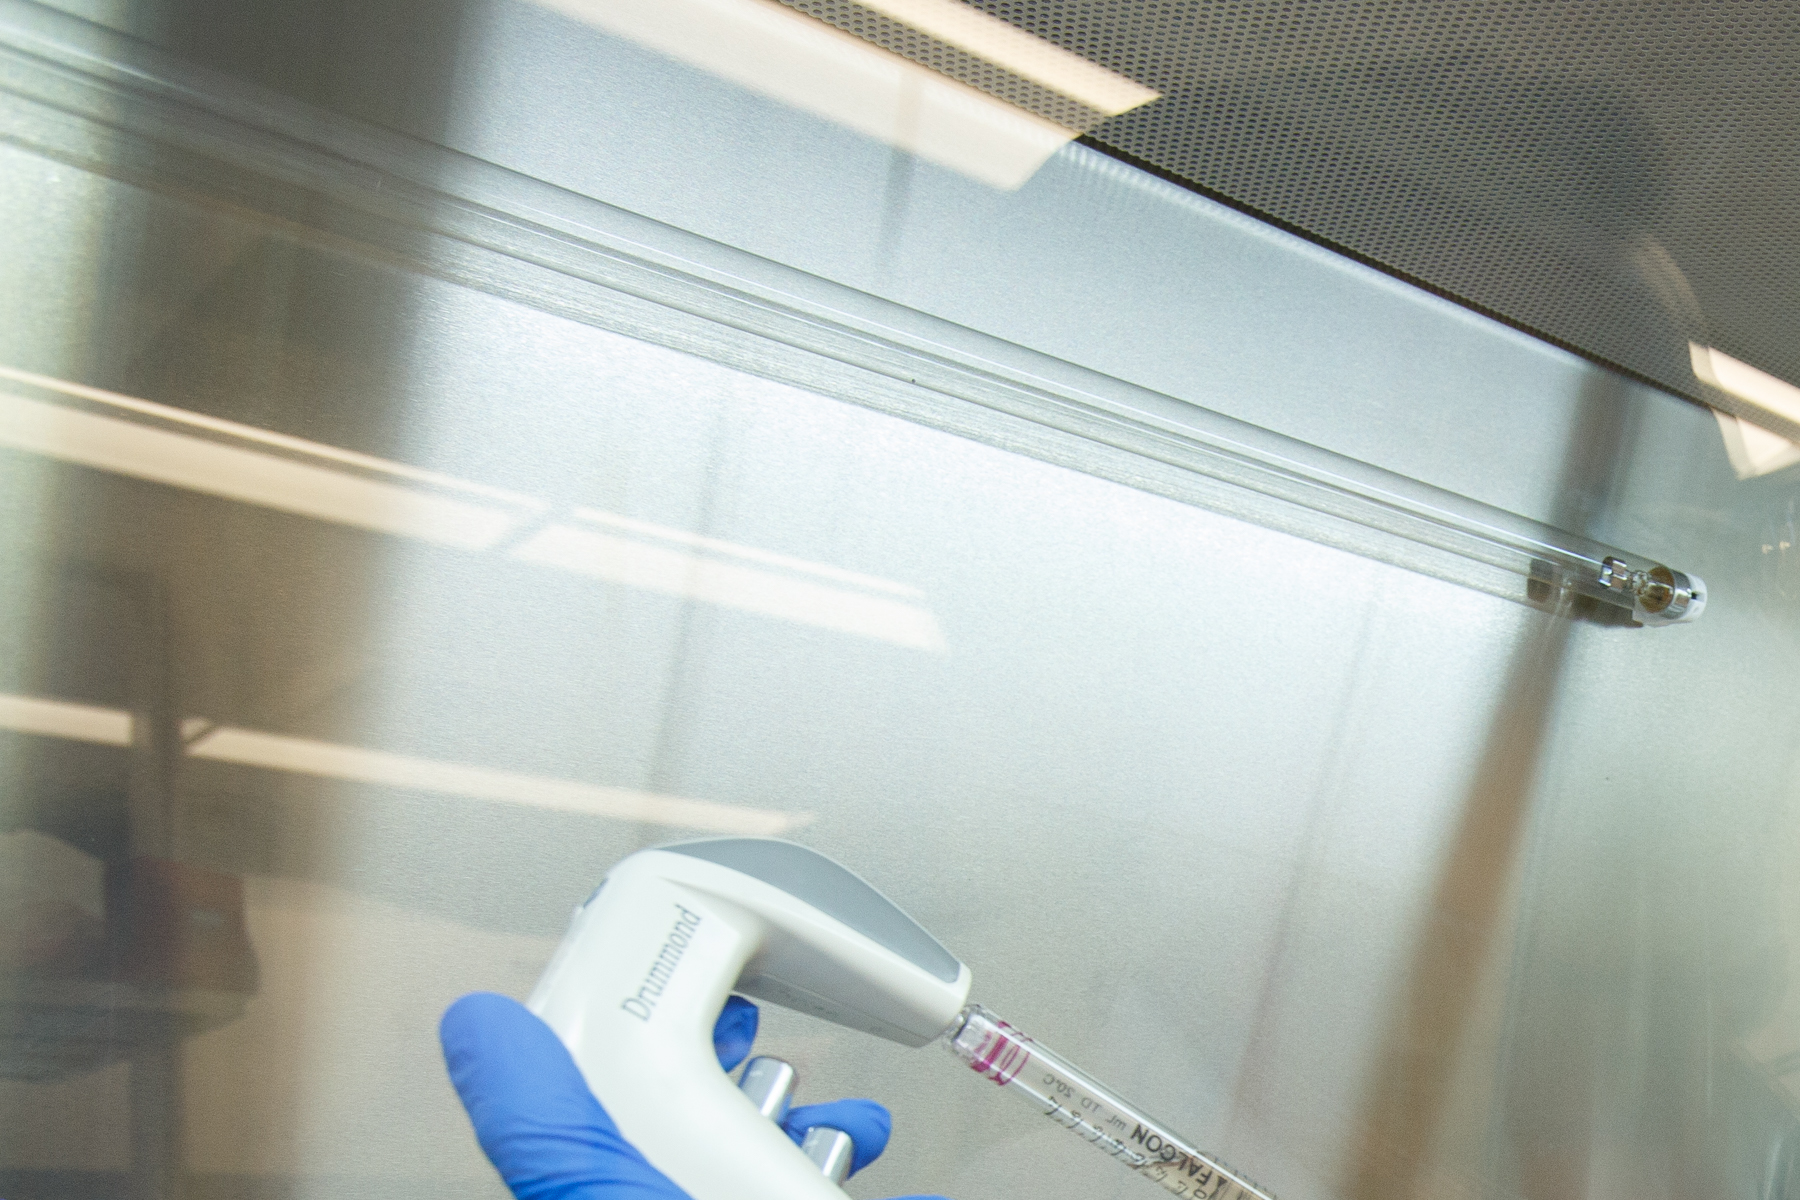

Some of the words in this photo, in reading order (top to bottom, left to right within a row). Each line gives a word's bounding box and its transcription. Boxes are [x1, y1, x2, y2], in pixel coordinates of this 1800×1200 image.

[619, 902, 702, 1022] Drummond
[1130, 1124, 1213, 1187] FALCON
[1193, 1188, 1207, 1200] 0
